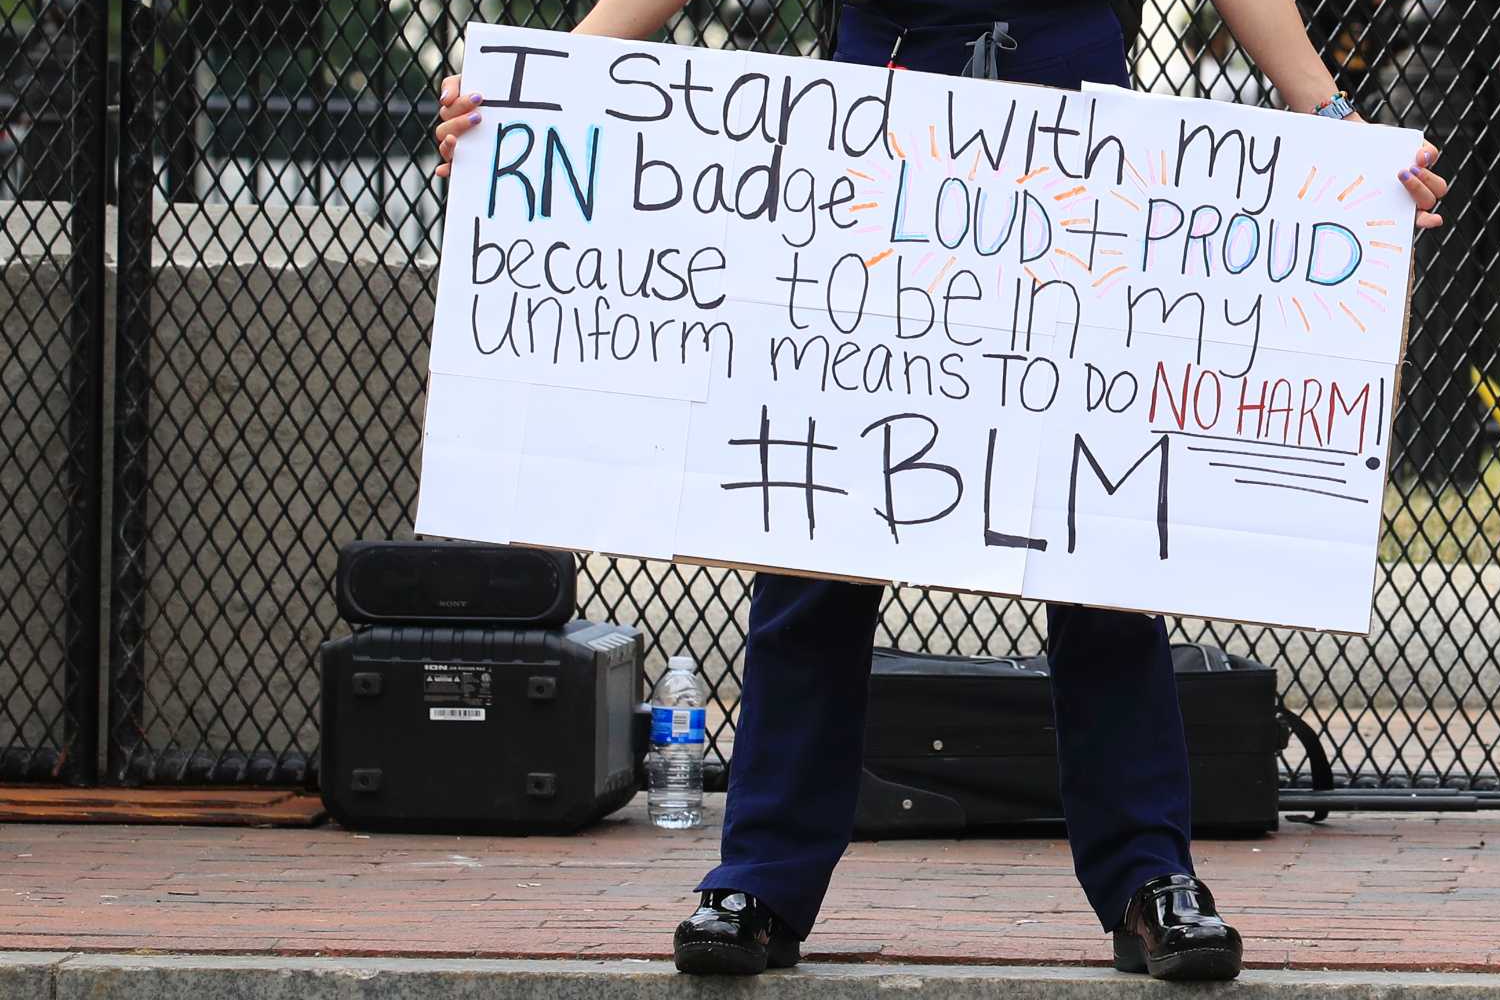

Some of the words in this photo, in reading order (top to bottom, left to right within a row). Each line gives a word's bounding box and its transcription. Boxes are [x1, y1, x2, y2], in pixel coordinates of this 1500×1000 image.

[480, 44, 569, 112] I
[1174, 118, 1281, 216] my
[486, 121, 603, 222] RN
[633, 131, 860, 248] badge
[888, 158, 1054, 267] LOUD
[1141, 197, 1365, 287] PROUD
[470, 215, 728, 310] because
[894, 254, 984, 348] be
[1125, 283, 1265, 380] my
[719, 404, 1170, 562] #BLM
[769, 334, 970, 400] means
[981, 351, 1061, 414] TO
[1083, 360, 1140, 414] DO
[1147, 359, 1223, 432] NO
[1235, 376, 1385, 470] HARM!
